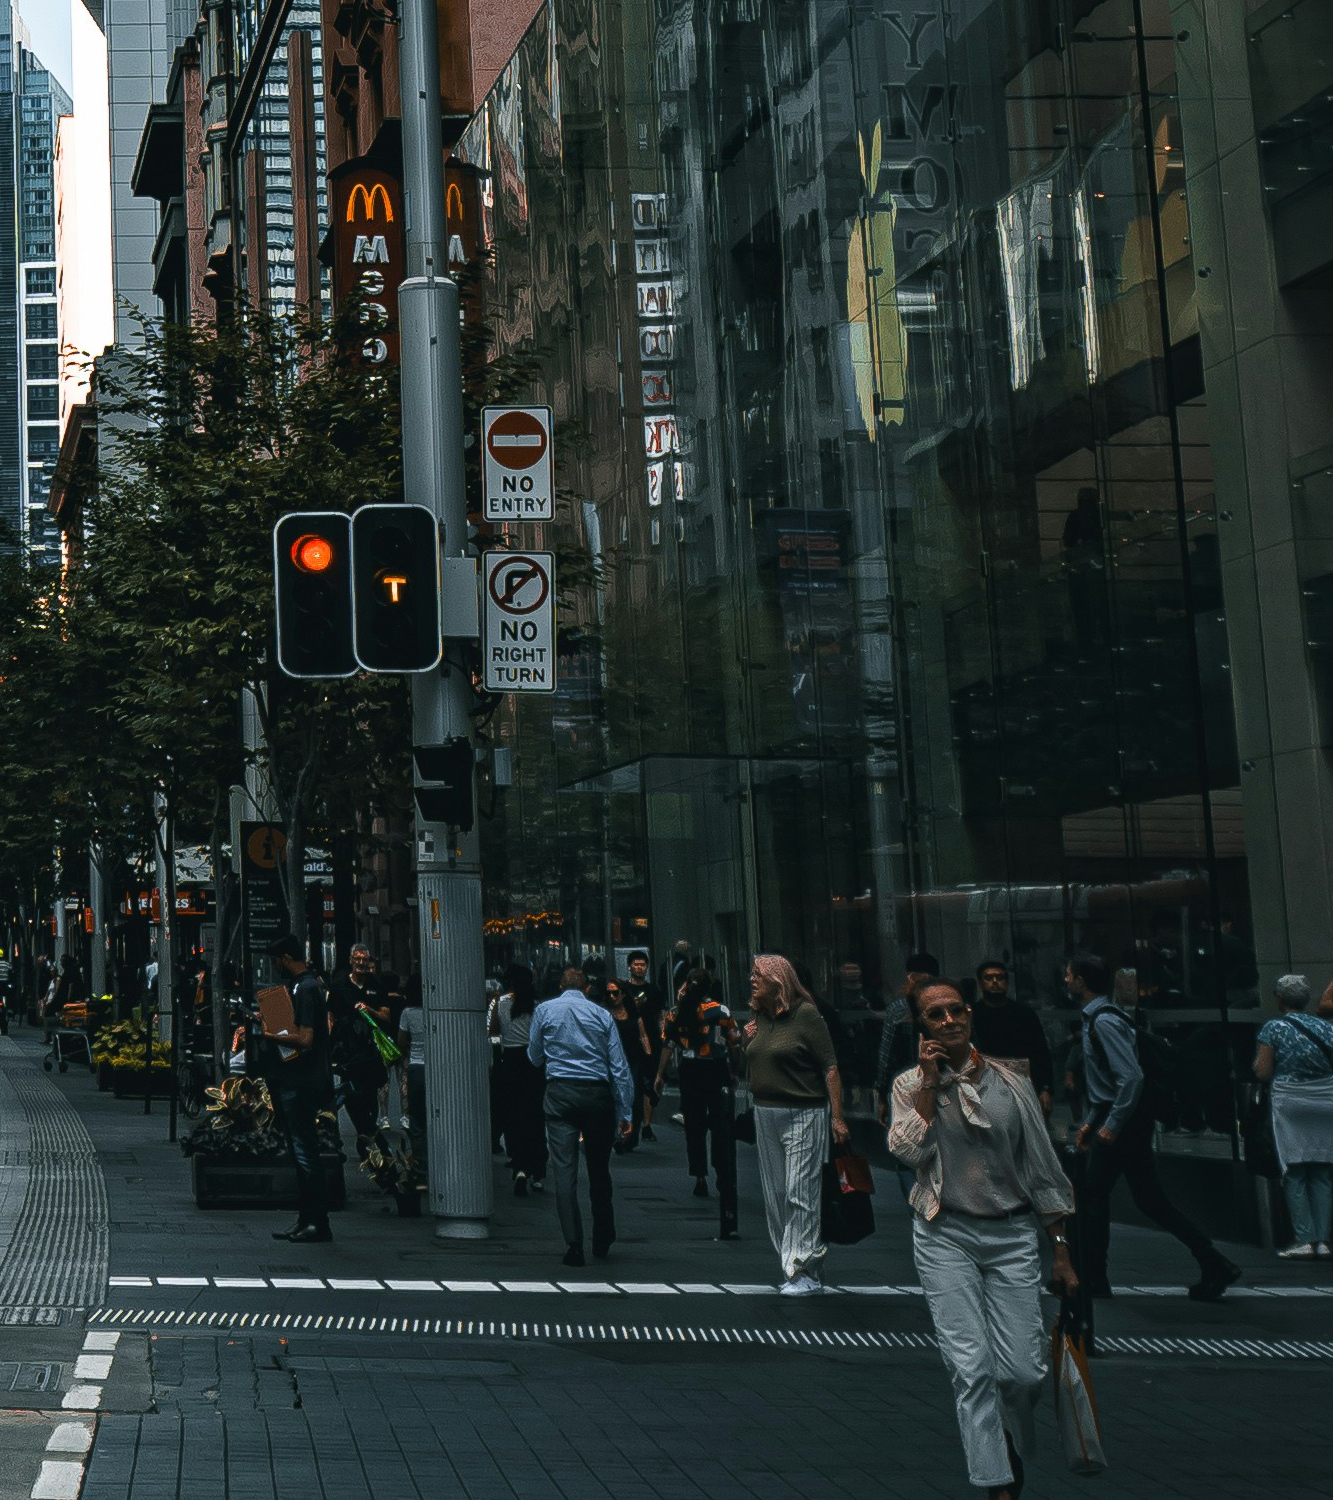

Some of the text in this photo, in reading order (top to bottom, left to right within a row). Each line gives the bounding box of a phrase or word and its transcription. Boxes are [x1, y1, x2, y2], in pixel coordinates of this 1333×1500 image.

[502, 476, 534, 493] NO
[490, 498, 547, 513] ENTRY
[501, 621, 538, 642] NO
[492, 647, 547, 662] RIGHT
[495, 667, 545, 683] TURN
